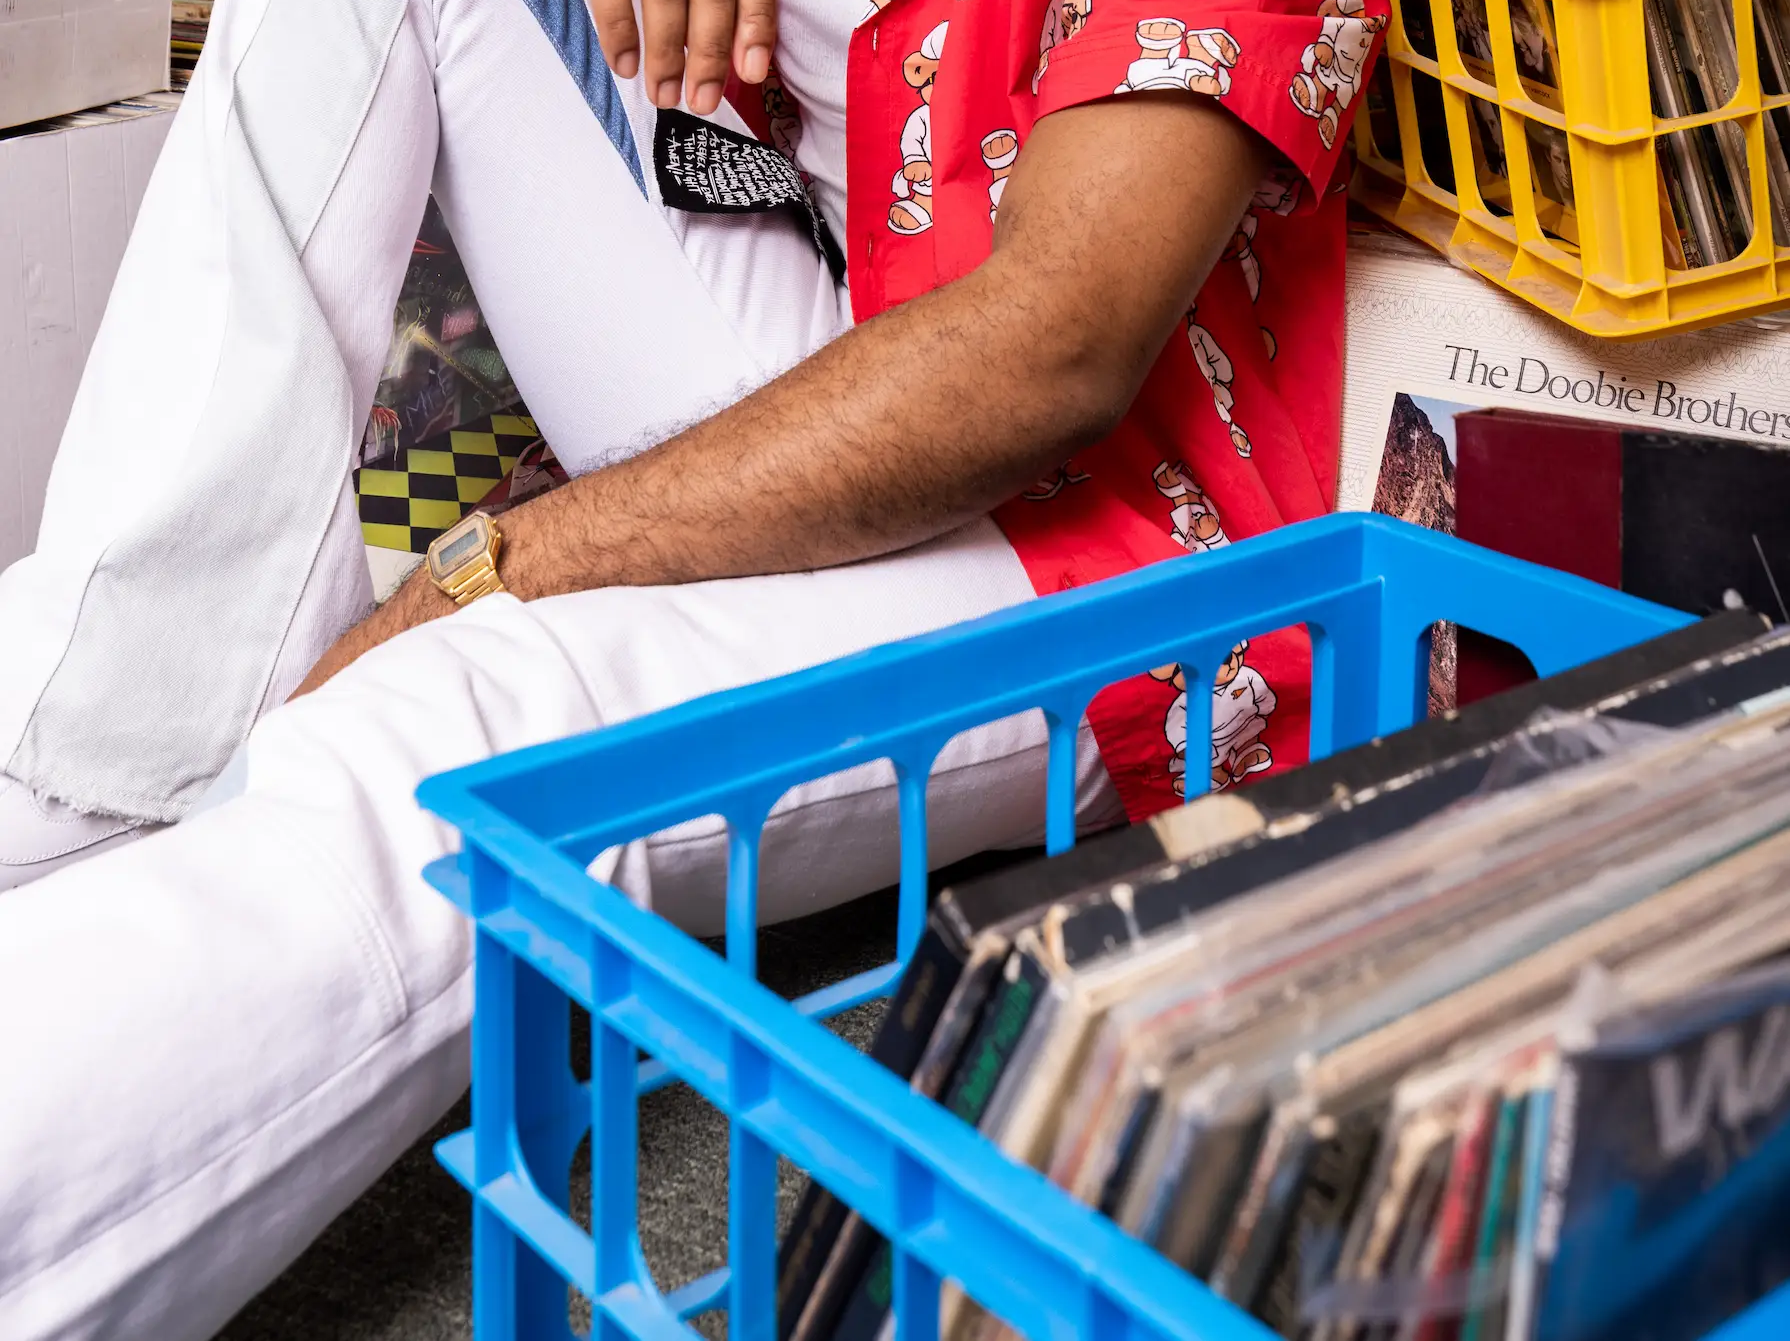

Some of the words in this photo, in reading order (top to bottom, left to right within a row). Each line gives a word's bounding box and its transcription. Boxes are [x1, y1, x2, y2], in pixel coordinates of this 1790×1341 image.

[683, 133, 696, 160] THIS
[695, 127, 708, 168] FOREVER
[709, 131, 721, 148] AS
[720, 138, 739, 161] AND
[709, 150, 722, 163] MY
[732, 151, 750, 172] WITH
[741, 144, 756, 162] ONE
[683, 163, 703, 195] NIGHT
[696, 171, 709, 186] AND
[710, 163, 741, 206] FOUNDATION
[700, 187, 716, 204] EVER
[1445, 344, 1508, 389] The
[1514, 357, 1646, 413] Doobie
[1651, 379, 1790, 440] Brothers
